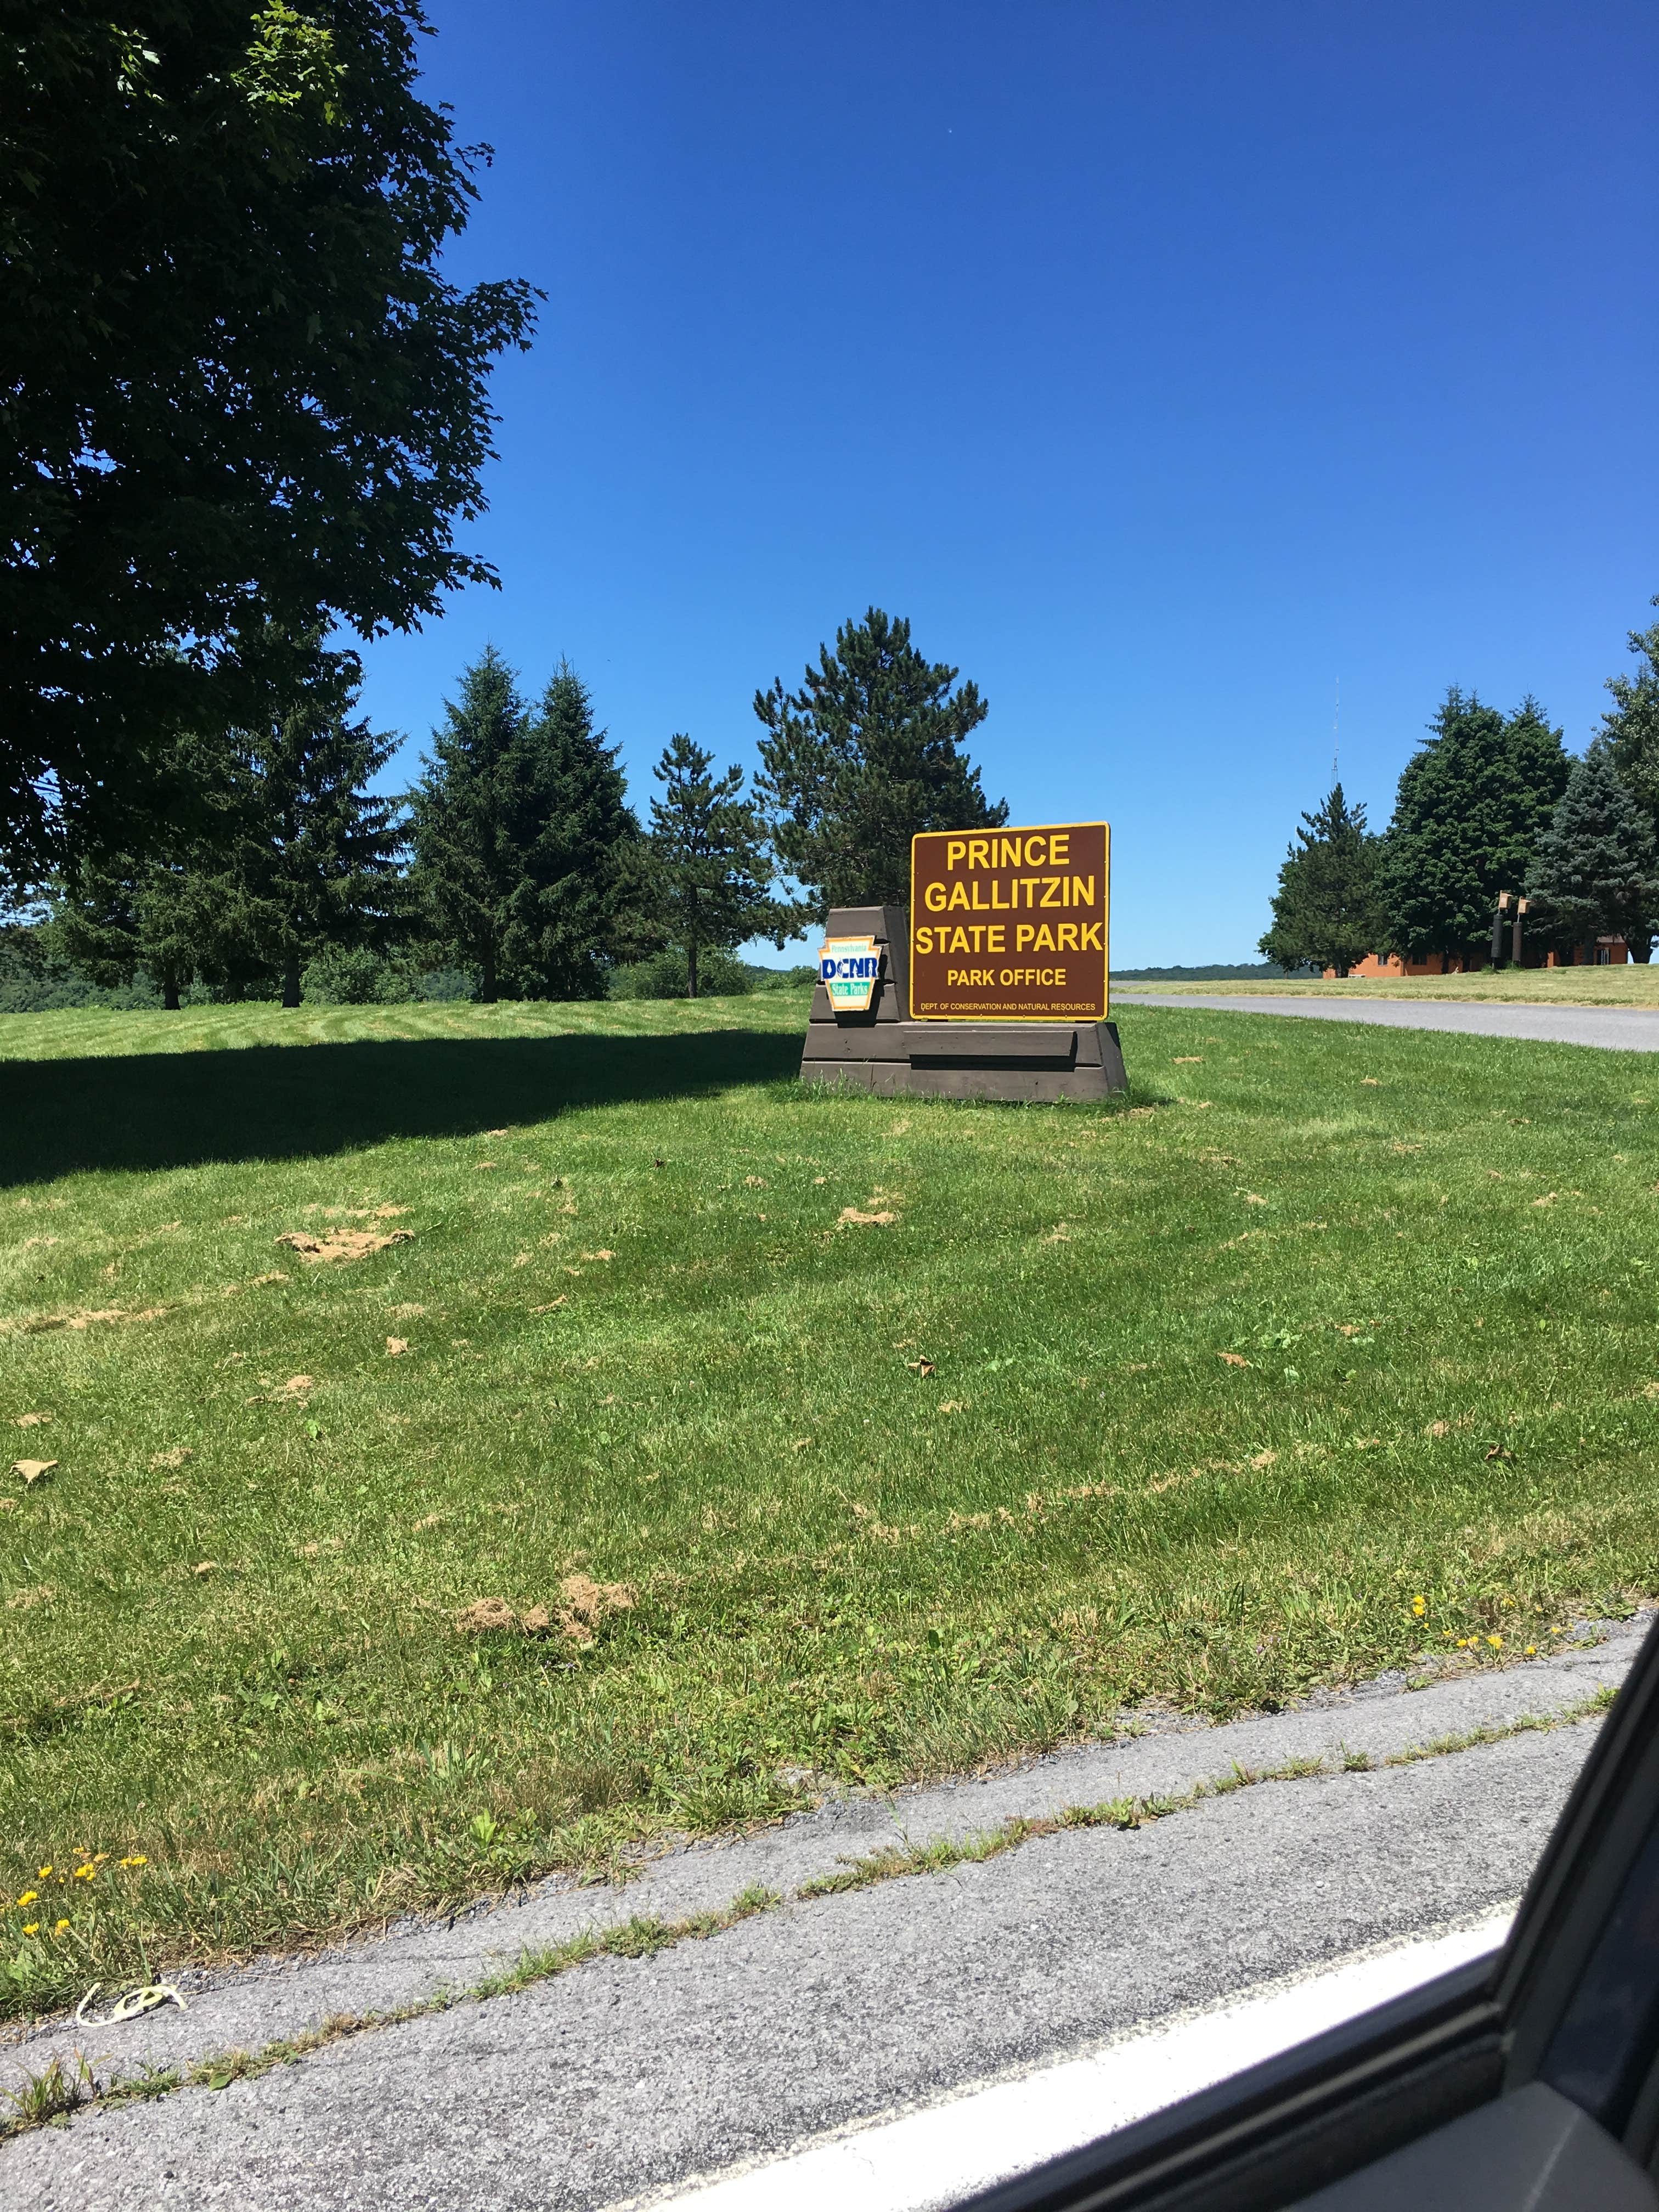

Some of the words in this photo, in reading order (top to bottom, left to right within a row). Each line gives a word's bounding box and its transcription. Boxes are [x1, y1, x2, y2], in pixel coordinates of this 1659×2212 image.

[947, 834, 1070, 871] PRINCE
[924, 875, 1094, 912] GALLITZIN
[832, 944, 867, 953] Pennsylvania
[916, 925, 1006, 954] STATE
[1017, 922, 1103, 952] PARK
[822, 957, 878, 979] DCNR
[947, 969, 995, 986] PARK
[1000, 968, 1066, 986] OFFICE
[832, 984, 849, 996] State
[850, 983, 868, 995] Parks
